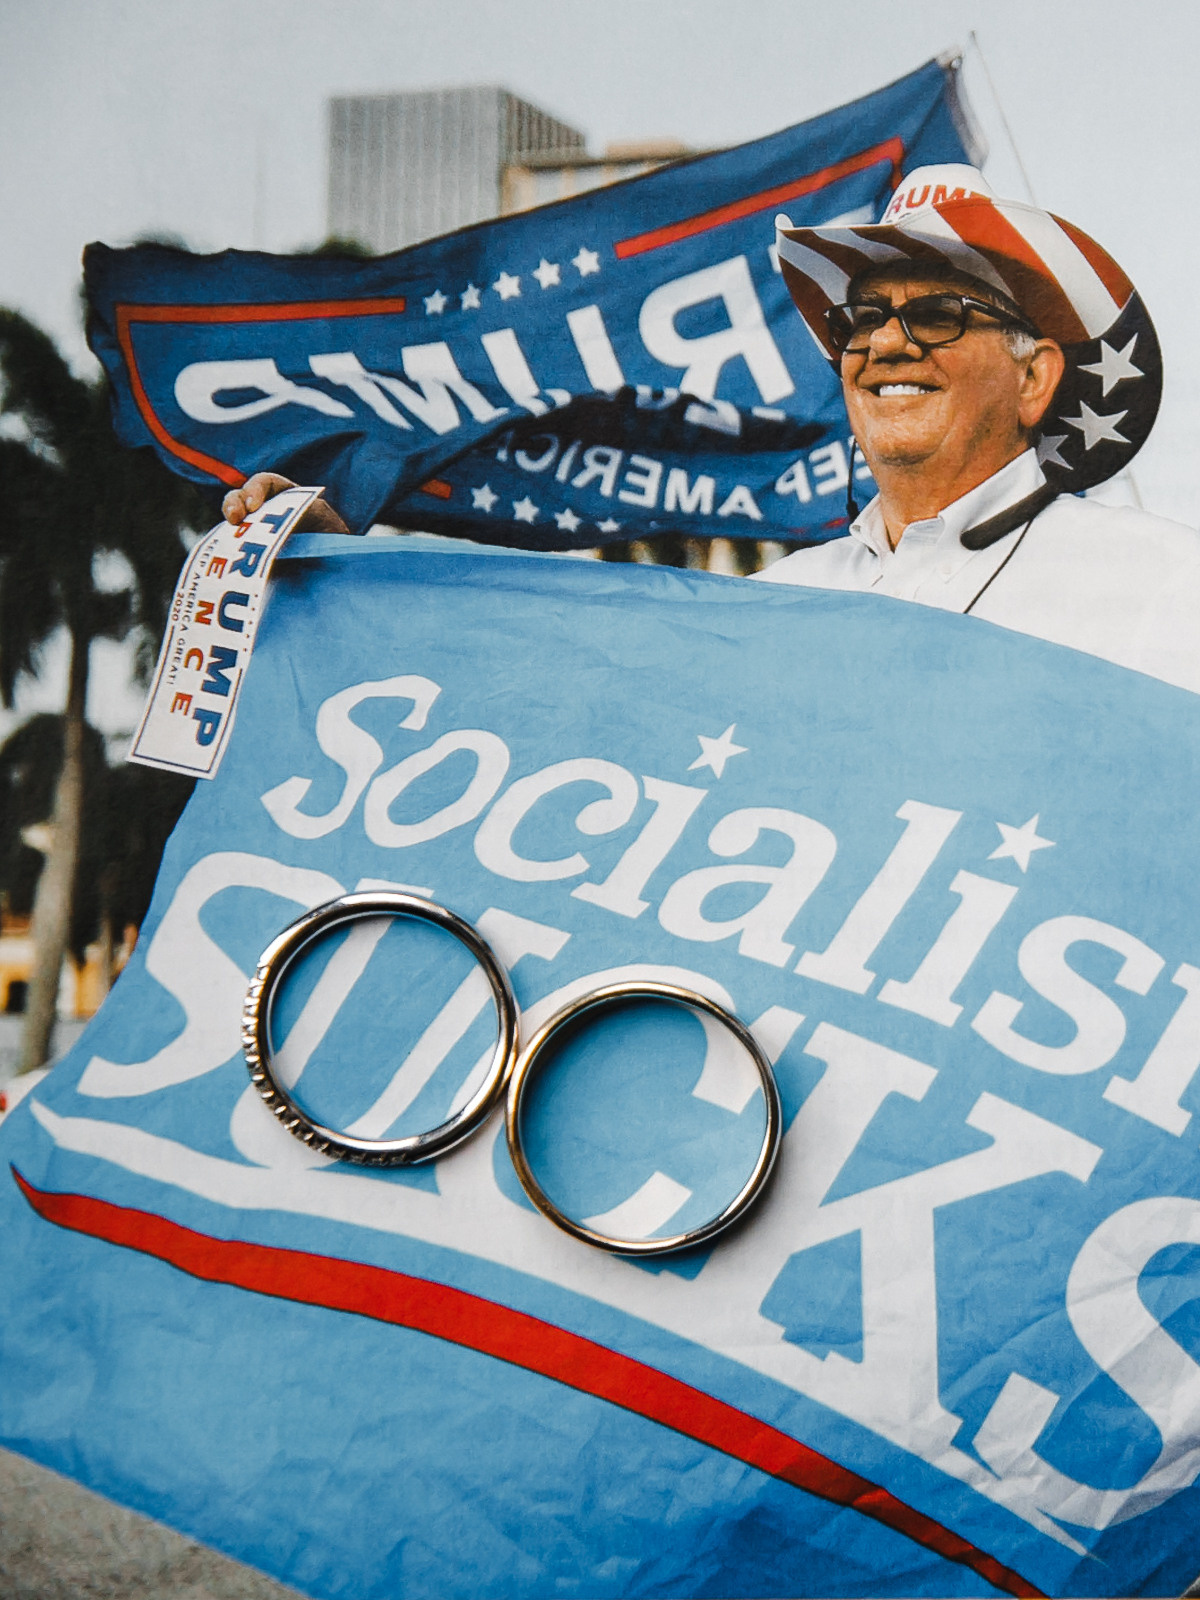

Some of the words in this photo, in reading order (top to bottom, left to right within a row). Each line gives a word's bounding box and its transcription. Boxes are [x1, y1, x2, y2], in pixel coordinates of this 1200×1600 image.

[197, 537, 219, 568] KEEP
[169, 521, 254, 716] PENCE
[170, 592, 186, 622] 2020
[179, 571, 201, 632] AMERICA
[192, 506, 296, 747] TRUMP
[164, 637, 187, 686] GREAT!
